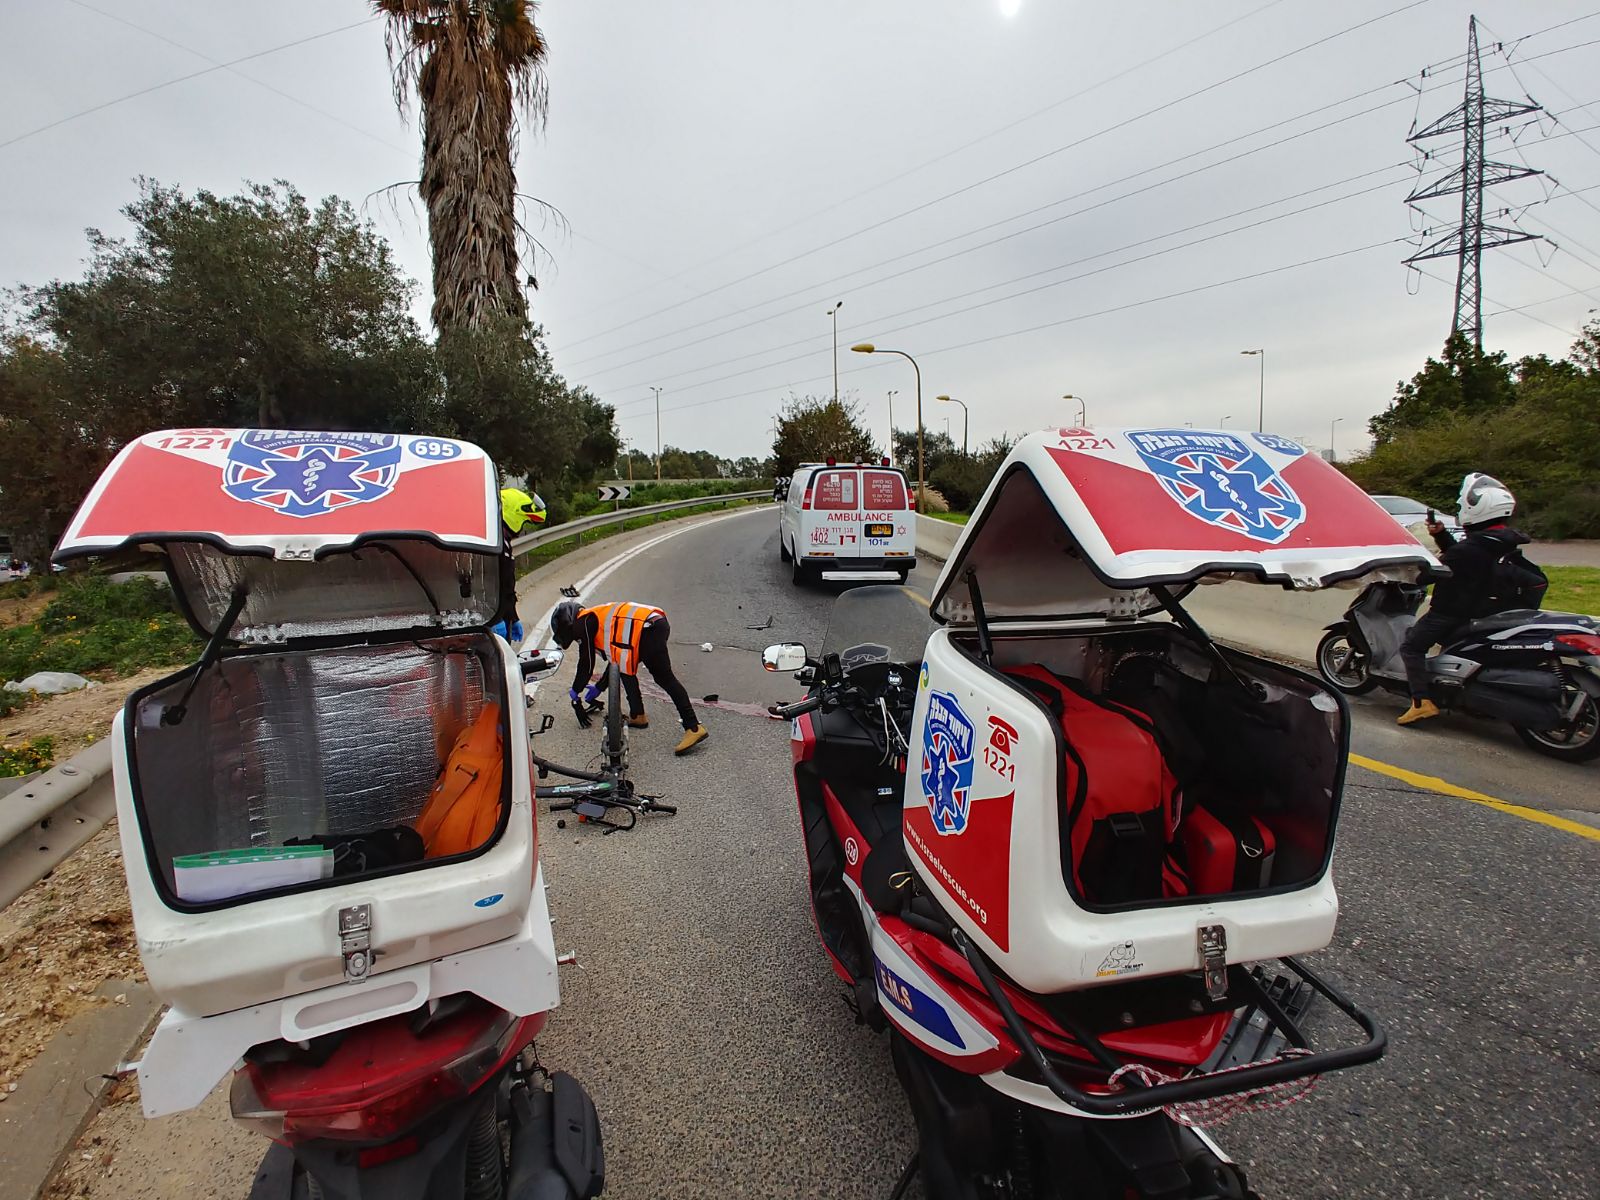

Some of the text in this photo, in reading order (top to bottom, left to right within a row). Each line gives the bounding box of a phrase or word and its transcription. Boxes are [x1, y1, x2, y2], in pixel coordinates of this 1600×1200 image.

[157, 437, 231, 450] 1221
[263, 439, 292, 449] UNITED
[415, 441, 454, 457] 695
[1058, 437, 1116, 450] 1221
[1134, 433, 1245, 454] איחוד הצלה
[827, 513, 893, 521] AMBULANCE
[810, 532, 828, 543] 1402
[930, 697, 948, 724] הצלה
[949, 712, 970, 756] איחוד
[983, 746, 1015, 783] 1221
[906, 819, 987, 924] www.israelrescue.org
